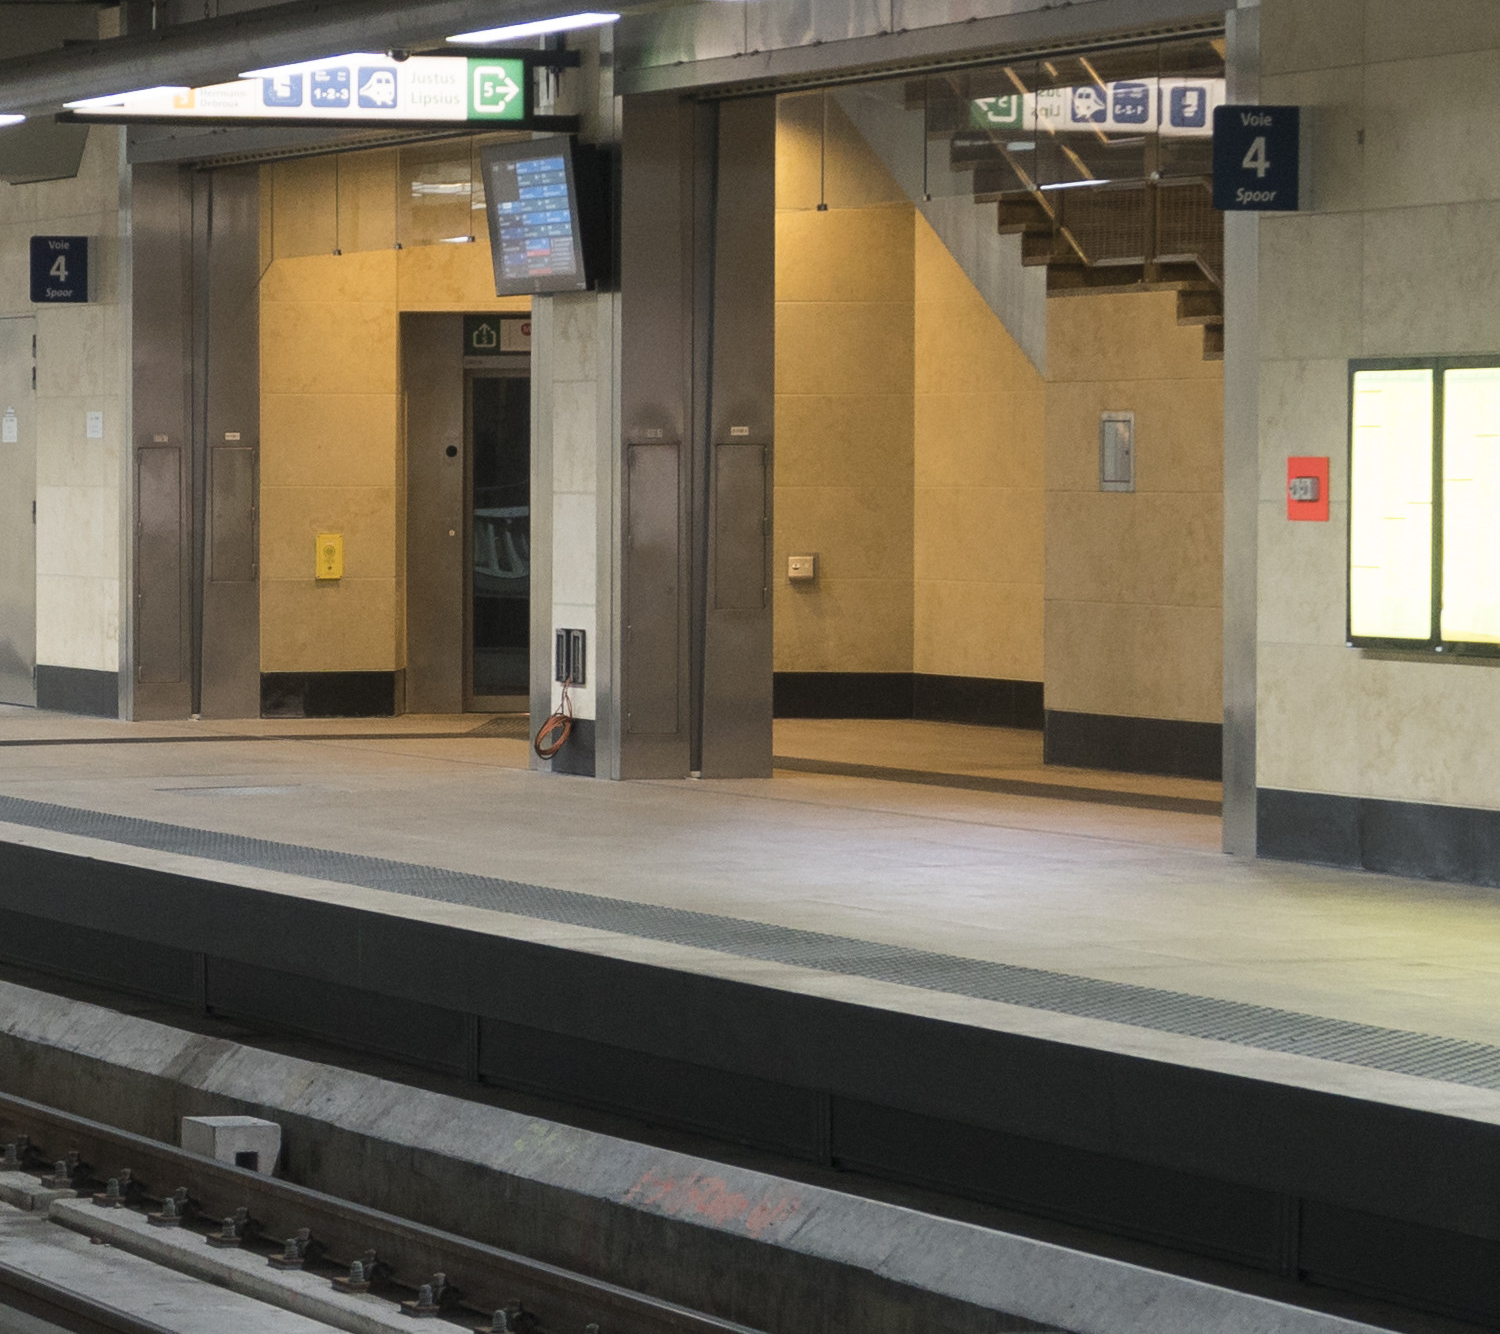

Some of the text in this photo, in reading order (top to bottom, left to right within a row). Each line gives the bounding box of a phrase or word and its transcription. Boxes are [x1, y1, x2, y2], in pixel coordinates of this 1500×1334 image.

[410, 70, 456, 84] Justus
[483, 81, 494, 98] 5
[199, 98, 240, 108] Debroux
[411, 91, 460, 107] Lipsius
[1240, 113, 1273, 127] Voie
[1241, 136, 1271, 178] 4
[1236, 187, 1277, 205] Spoor
[47, 239, 71, 250] Voie
[49, 254, 69, 282] 4
[45, 287, 73, 300] Spoor
